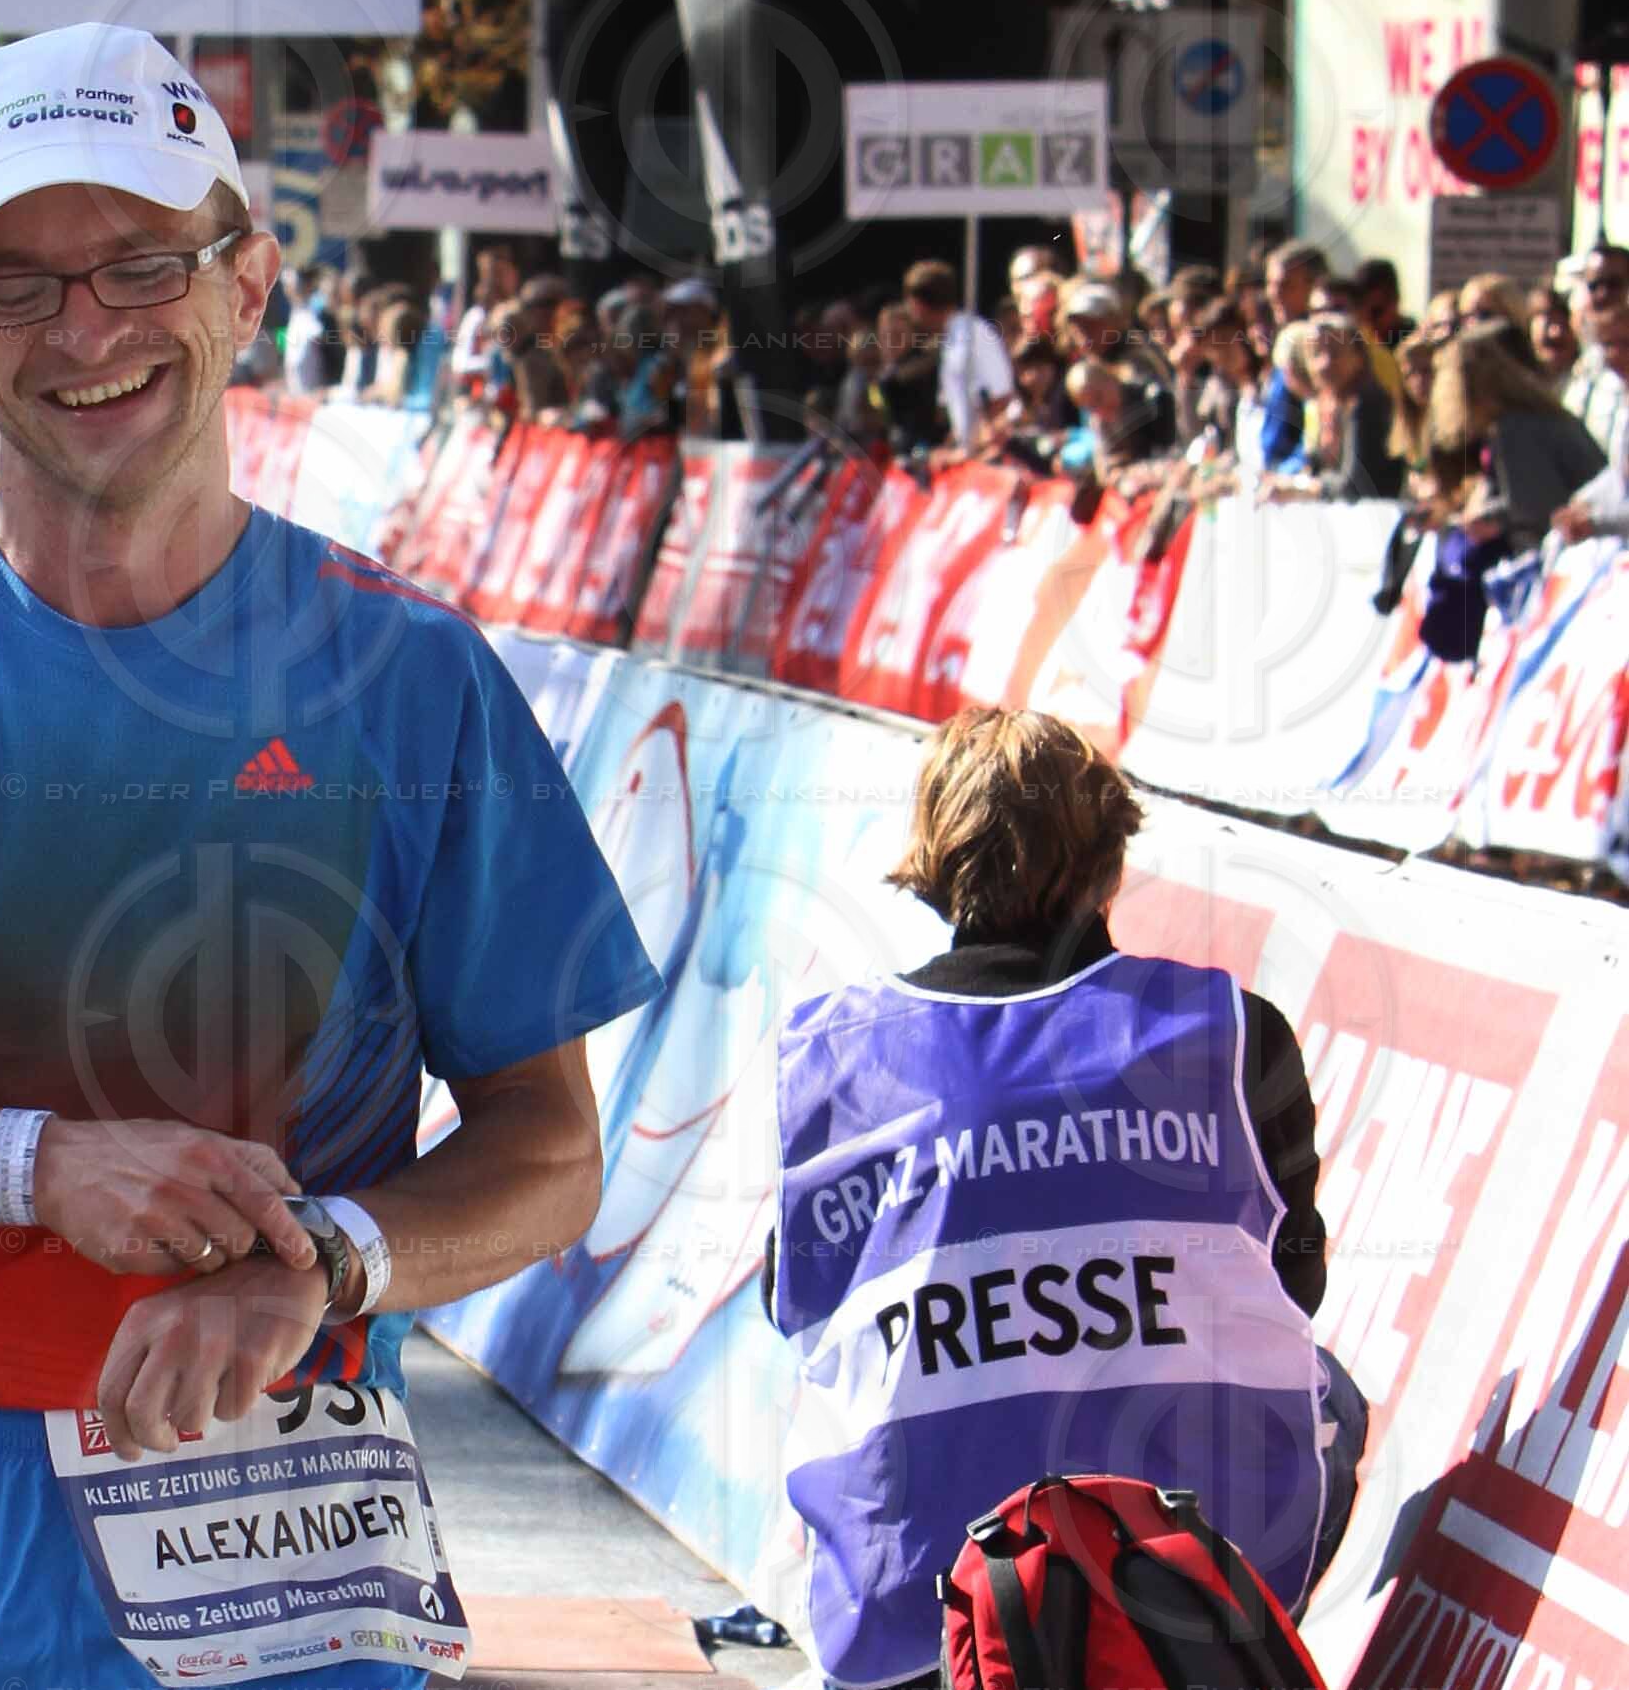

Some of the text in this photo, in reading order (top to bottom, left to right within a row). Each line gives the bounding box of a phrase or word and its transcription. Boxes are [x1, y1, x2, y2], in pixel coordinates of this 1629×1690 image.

[74, 86, 136, 107] Partner
[859, 134, 1096, 188] GRAZ
[811, 1108, 1221, 1246] GRAZ MARATHON
[875, 1255, 1187, 1388] PRESSE
[84, 1480, 154, 1508] KLEINE
[157, 1464, 243, 1500] ZEITUNG
[246, 1457, 298, 1488] GRAZ
[301, 1448, 391, 1478] MARATHON
[154, 1493, 411, 1571] ALEXANDER
[125, 1608, 193, 1634] Kleine
[195, 1596, 281, 1630] Zeitung
[287, 1579, 386, 1610] Marathon
[258, 1641, 328, 1665] SPARKASSE
